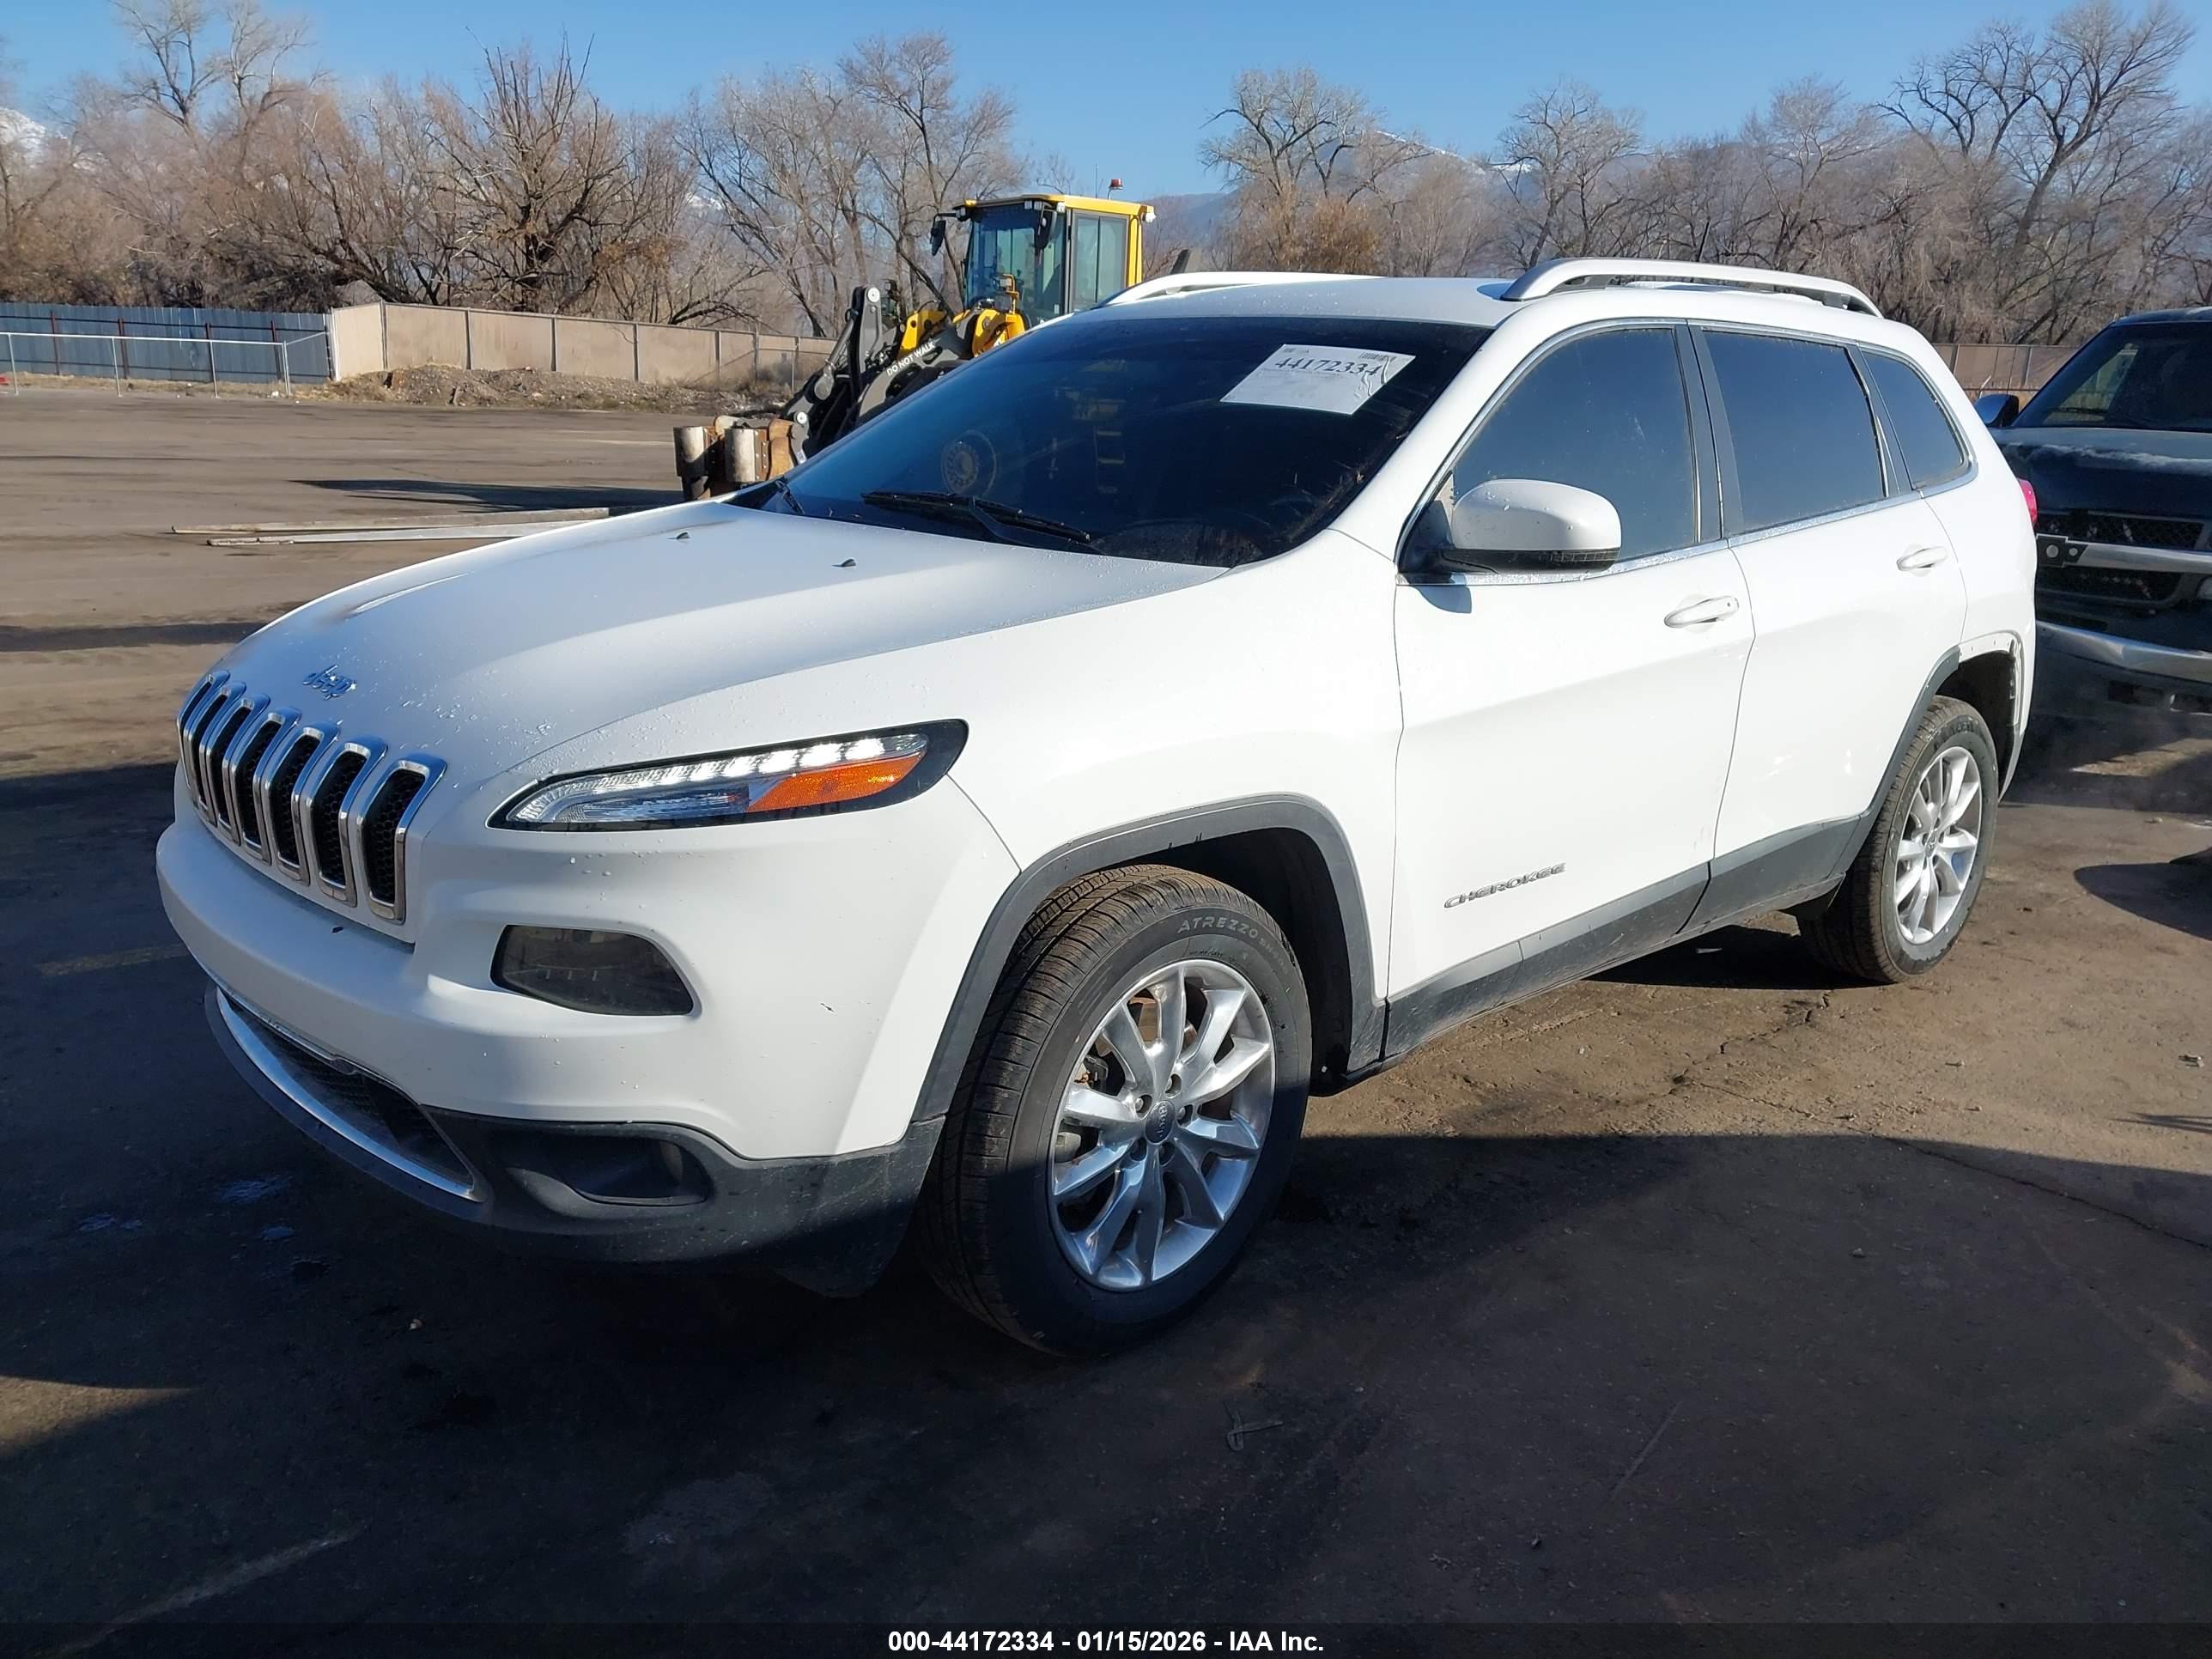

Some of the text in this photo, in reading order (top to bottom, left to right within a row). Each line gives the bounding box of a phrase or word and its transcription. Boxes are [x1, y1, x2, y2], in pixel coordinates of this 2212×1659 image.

[886, 340, 936, 376] DO NOT WALK
[1274, 356, 1382, 376] 44172334
[1443, 862, 1566, 908] CHEROKEE
[1175, 915, 1259, 939] ATREZZO
